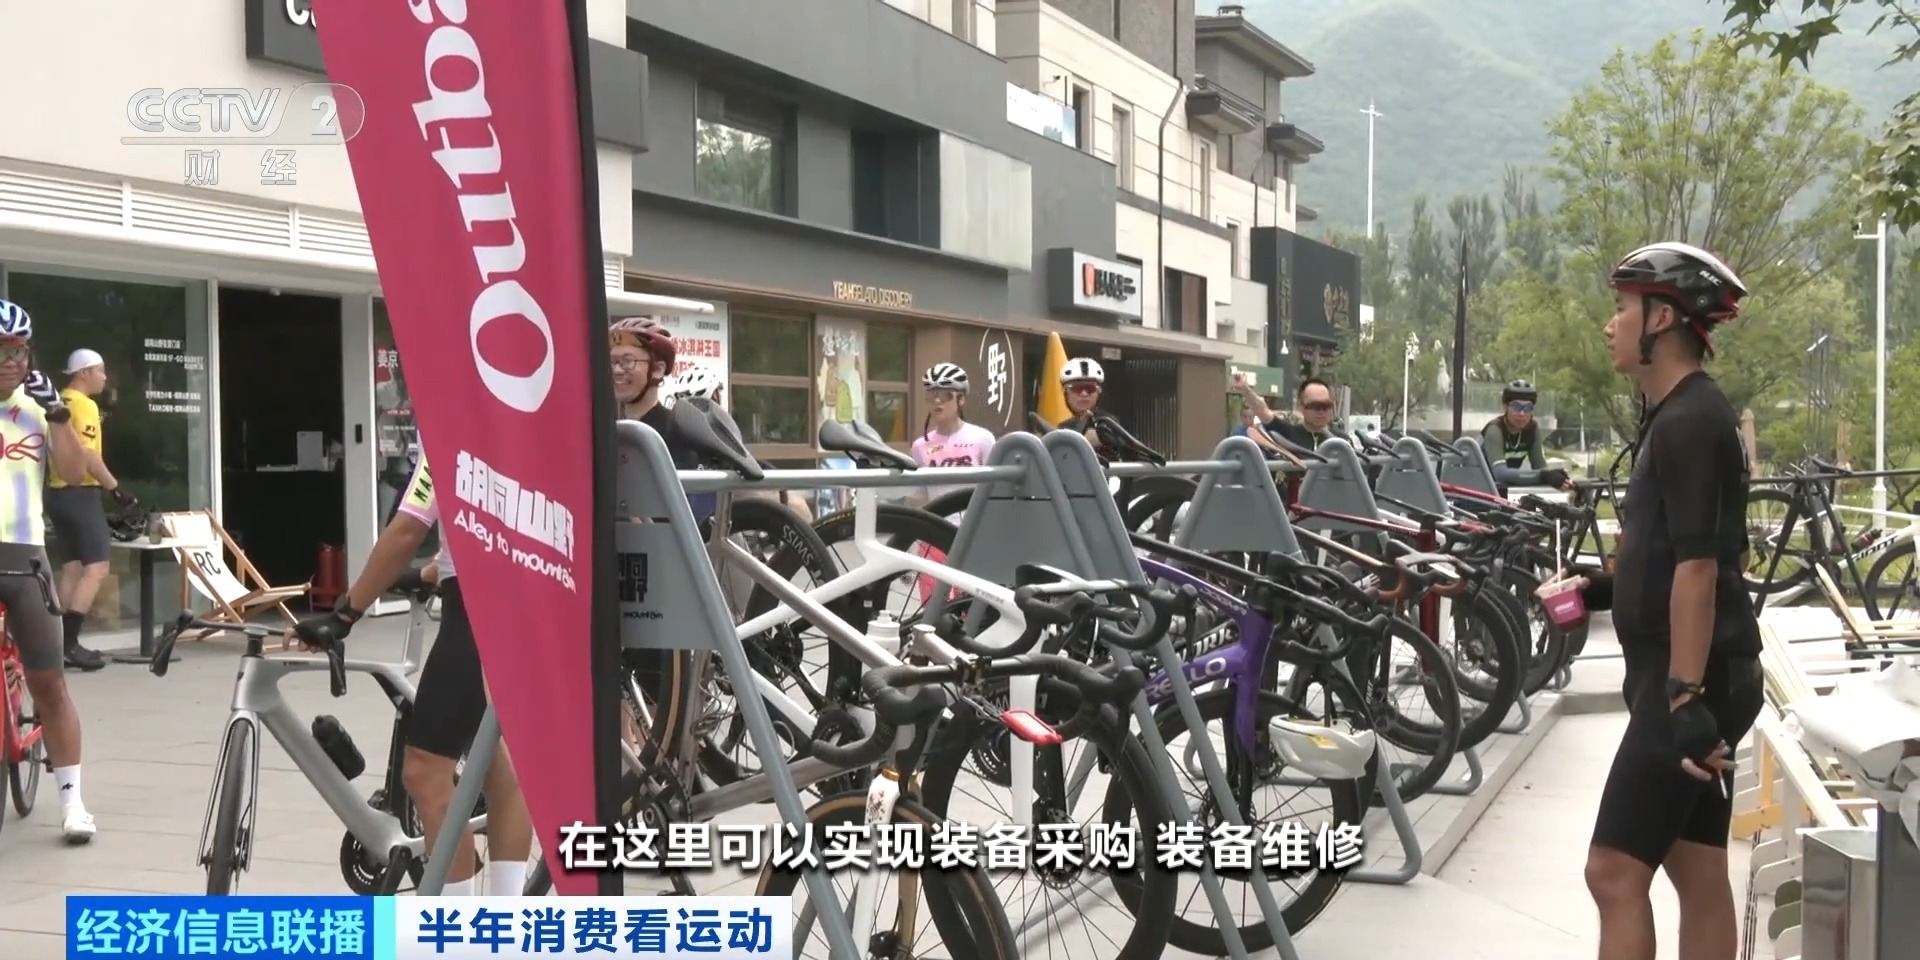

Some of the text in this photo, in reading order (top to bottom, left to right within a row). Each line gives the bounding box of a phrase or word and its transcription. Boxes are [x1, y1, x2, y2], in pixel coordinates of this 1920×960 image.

[987, 342, 1007, 413] 野
[453, 509, 493, 552] Alley
[496, 531, 509, 556] to
[512, 547, 577, 594] mountain
